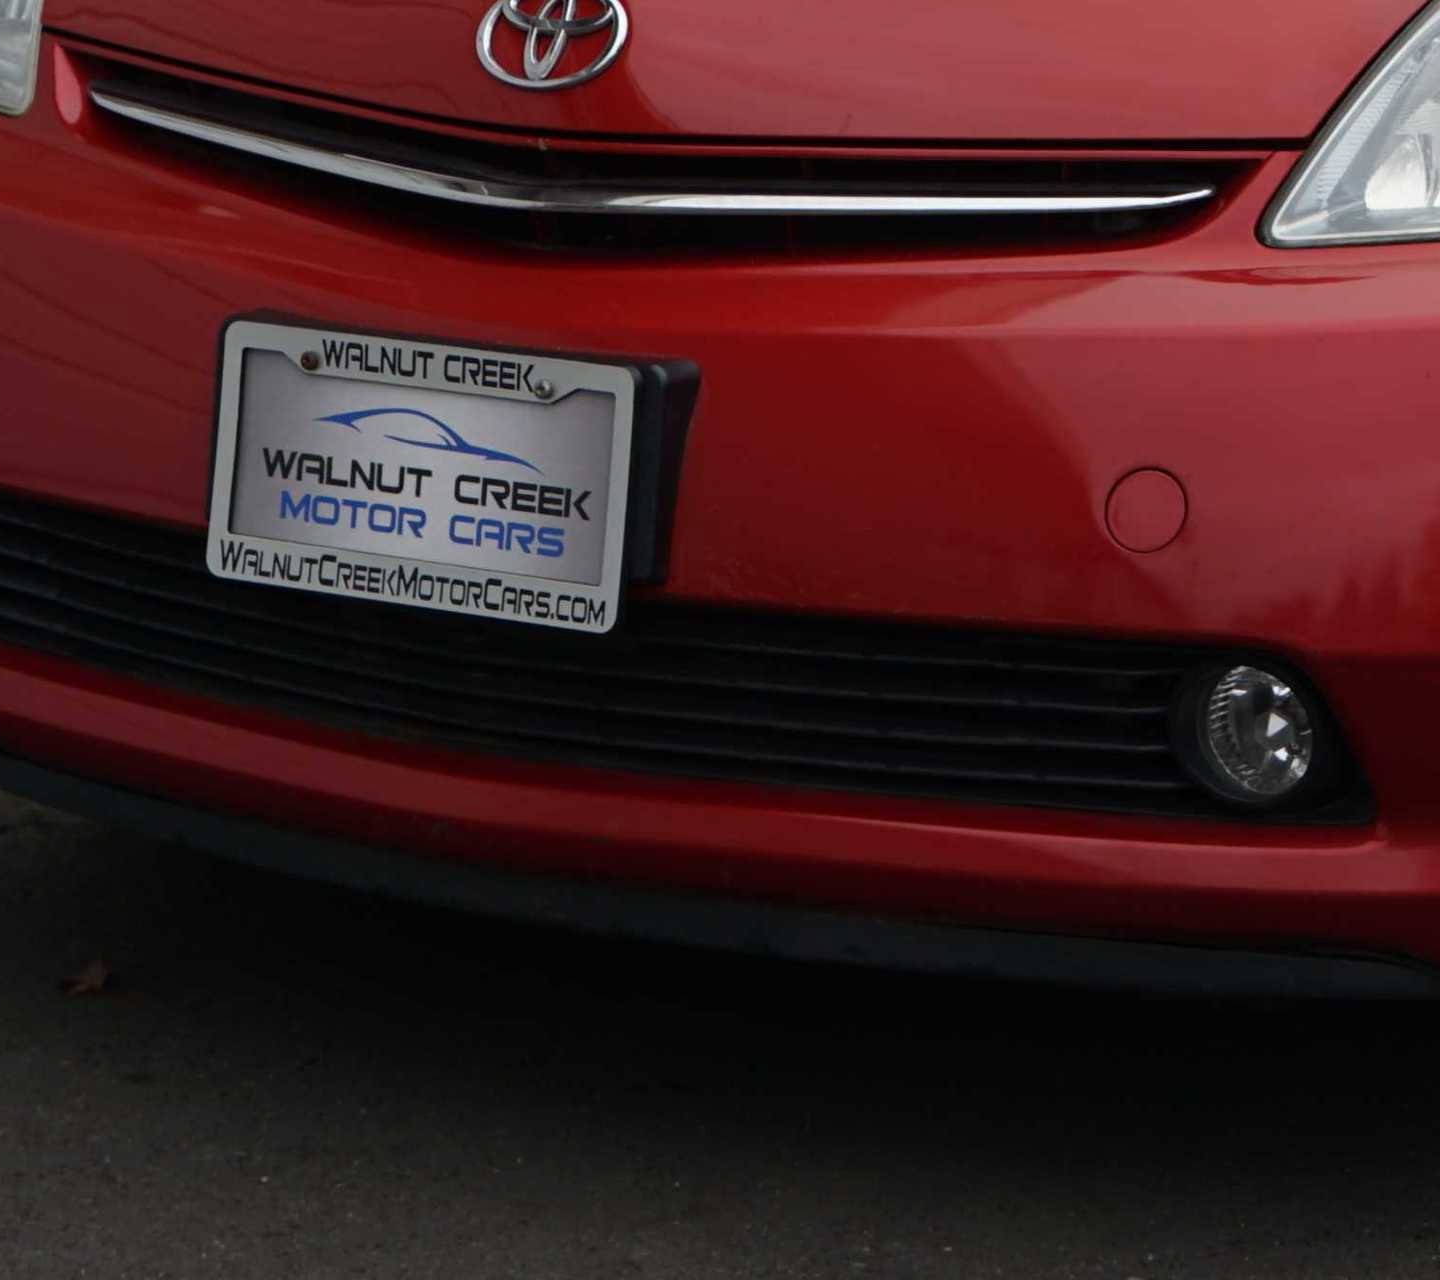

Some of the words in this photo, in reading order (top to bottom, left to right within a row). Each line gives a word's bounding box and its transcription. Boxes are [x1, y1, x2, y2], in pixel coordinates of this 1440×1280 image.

[322, 339, 435, 380] WALNUT
[443, 353, 536, 394] CREEK
[262, 447, 433, 498] WALNUT
[453, 473, 593, 522] CREEK
[278, 490, 427, 539] MOTOR
[448, 514, 567, 559] CARS
